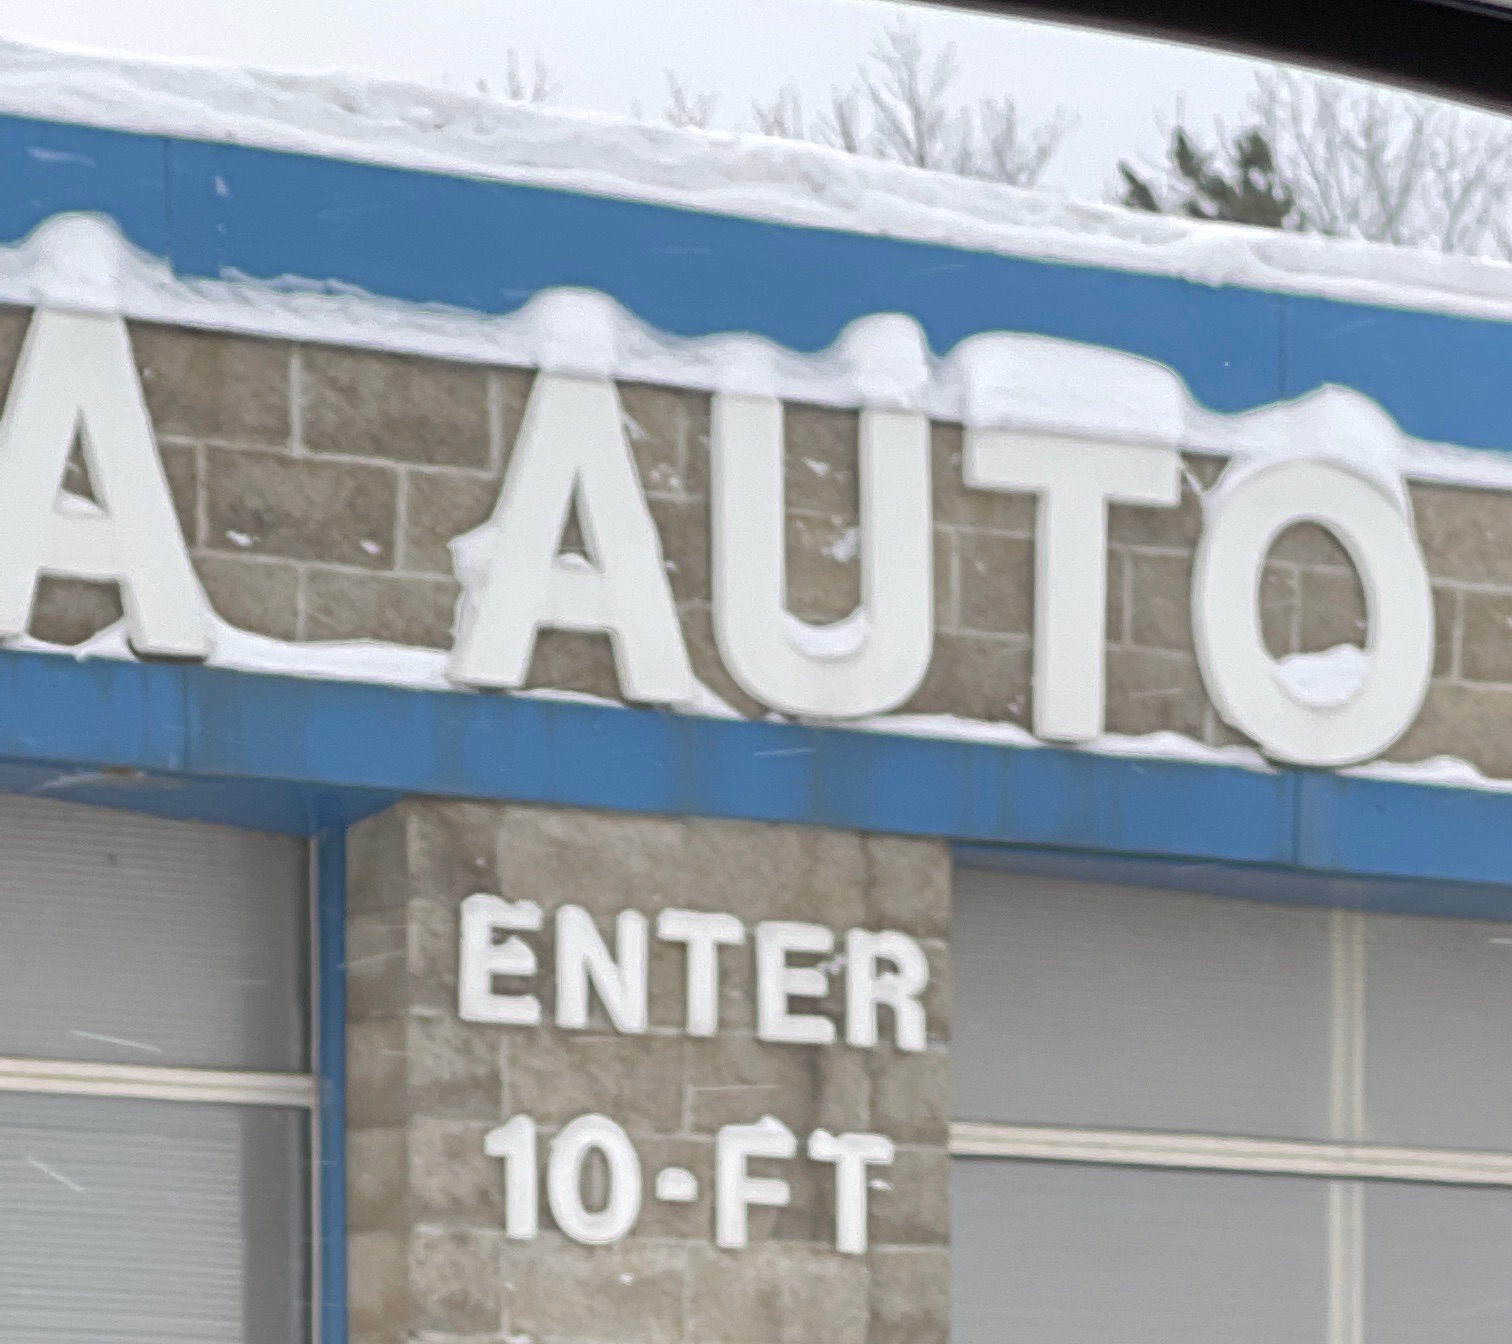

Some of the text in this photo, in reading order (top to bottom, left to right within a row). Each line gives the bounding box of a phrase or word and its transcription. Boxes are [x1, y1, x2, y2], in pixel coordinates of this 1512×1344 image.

[450, 366, 1435, 767] AUTO
[458, 893, 929, 1052] ENTER
[484, 1113, 896, 1255] 10-FT
